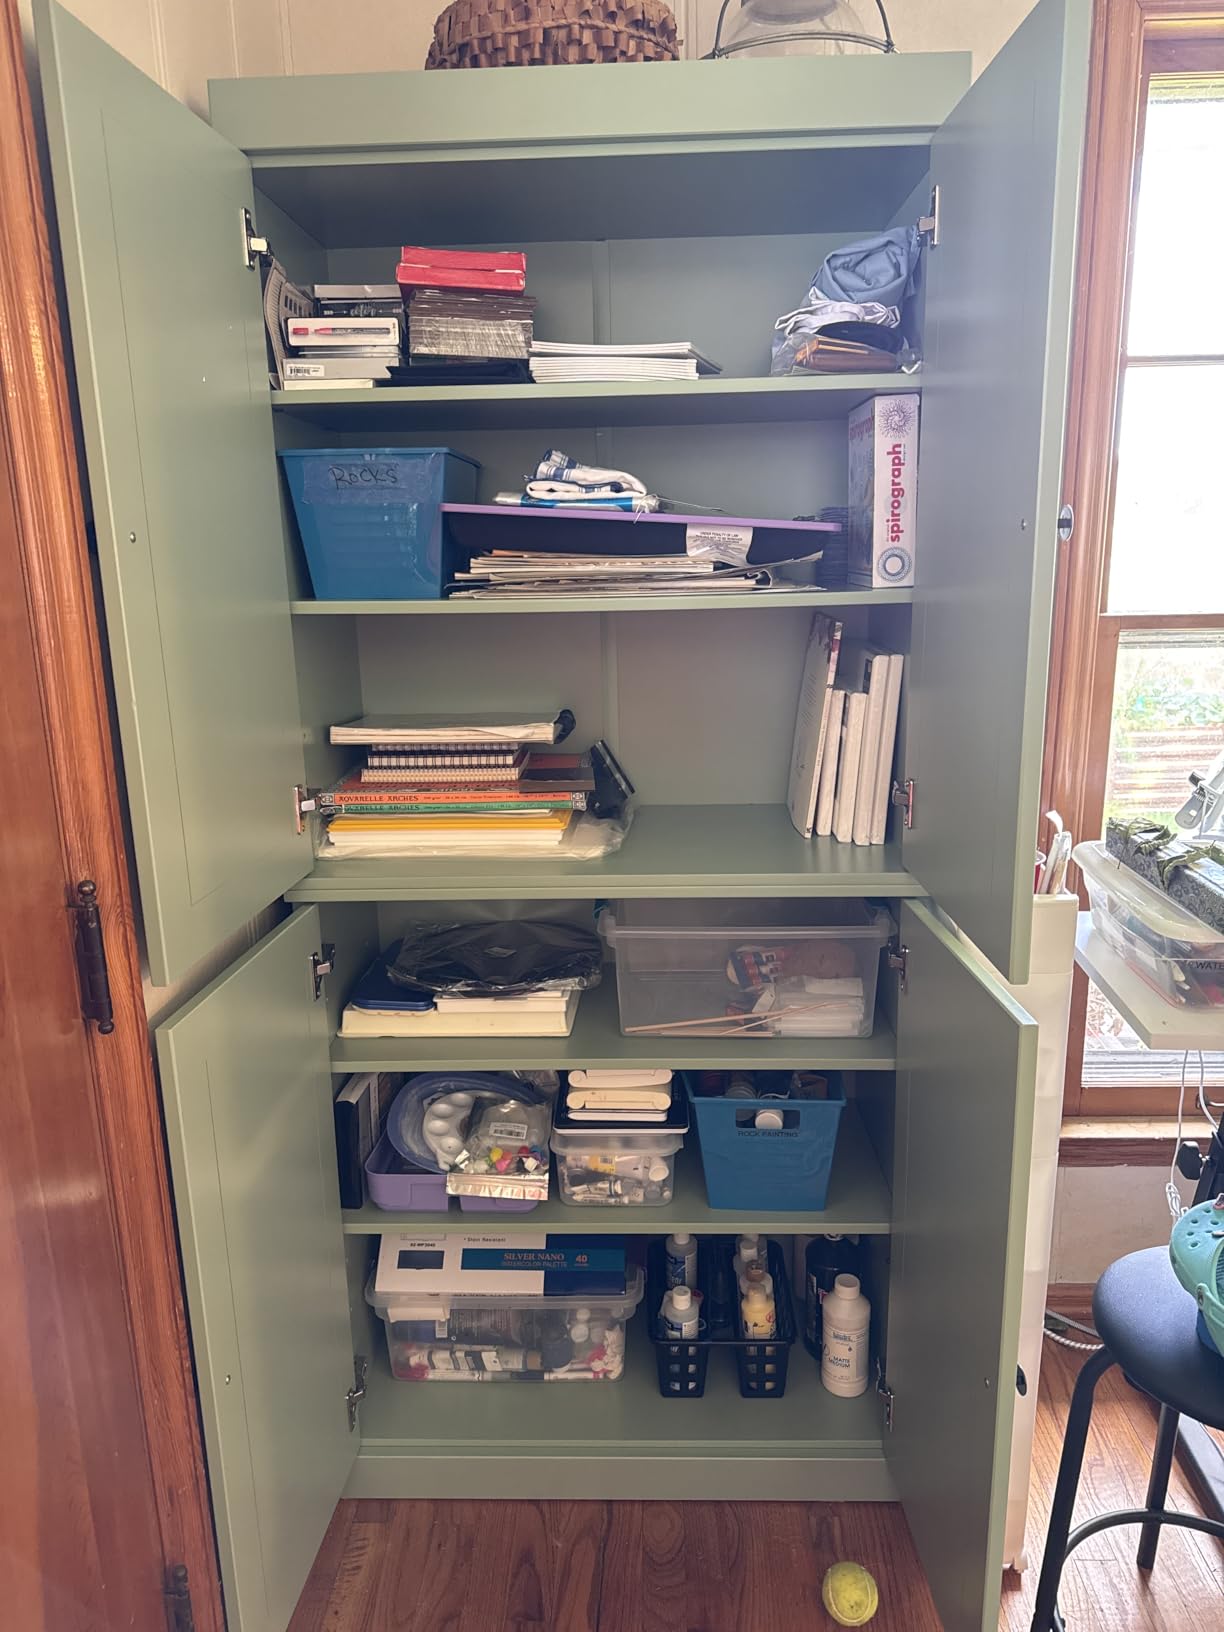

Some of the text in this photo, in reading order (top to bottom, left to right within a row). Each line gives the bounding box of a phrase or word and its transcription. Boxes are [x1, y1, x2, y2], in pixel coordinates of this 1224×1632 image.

[886, 443, 906, 542] spirograph
[761, 1130, 799, 1138] PAINTING
[503, 1252, 588, 1263] SILVER NANO 40
